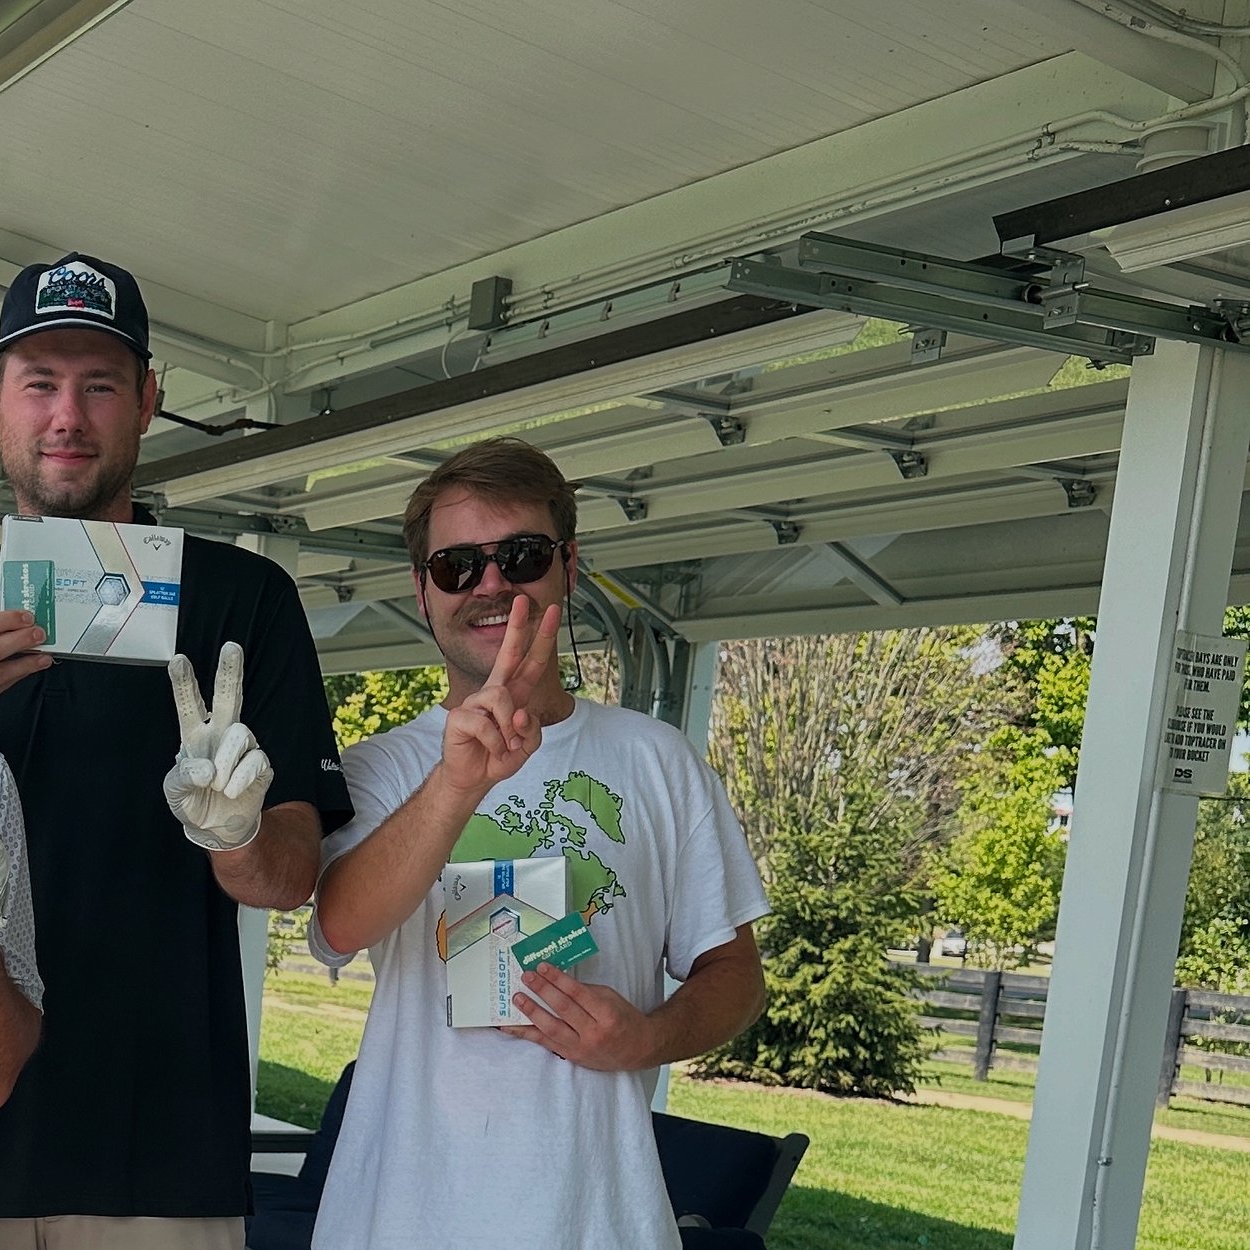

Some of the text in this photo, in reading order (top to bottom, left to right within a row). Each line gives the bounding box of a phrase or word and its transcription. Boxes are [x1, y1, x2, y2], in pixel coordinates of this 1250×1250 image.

[48, 266, 106, 289] Coors
[1191, 707, 1202, 719] SEE
[1203, 709, 1214, 721] THE
[1174, 768, 1192, 778] DS
[523, 941, 558, 965] different
[557, 926, 587, 945] strokes
